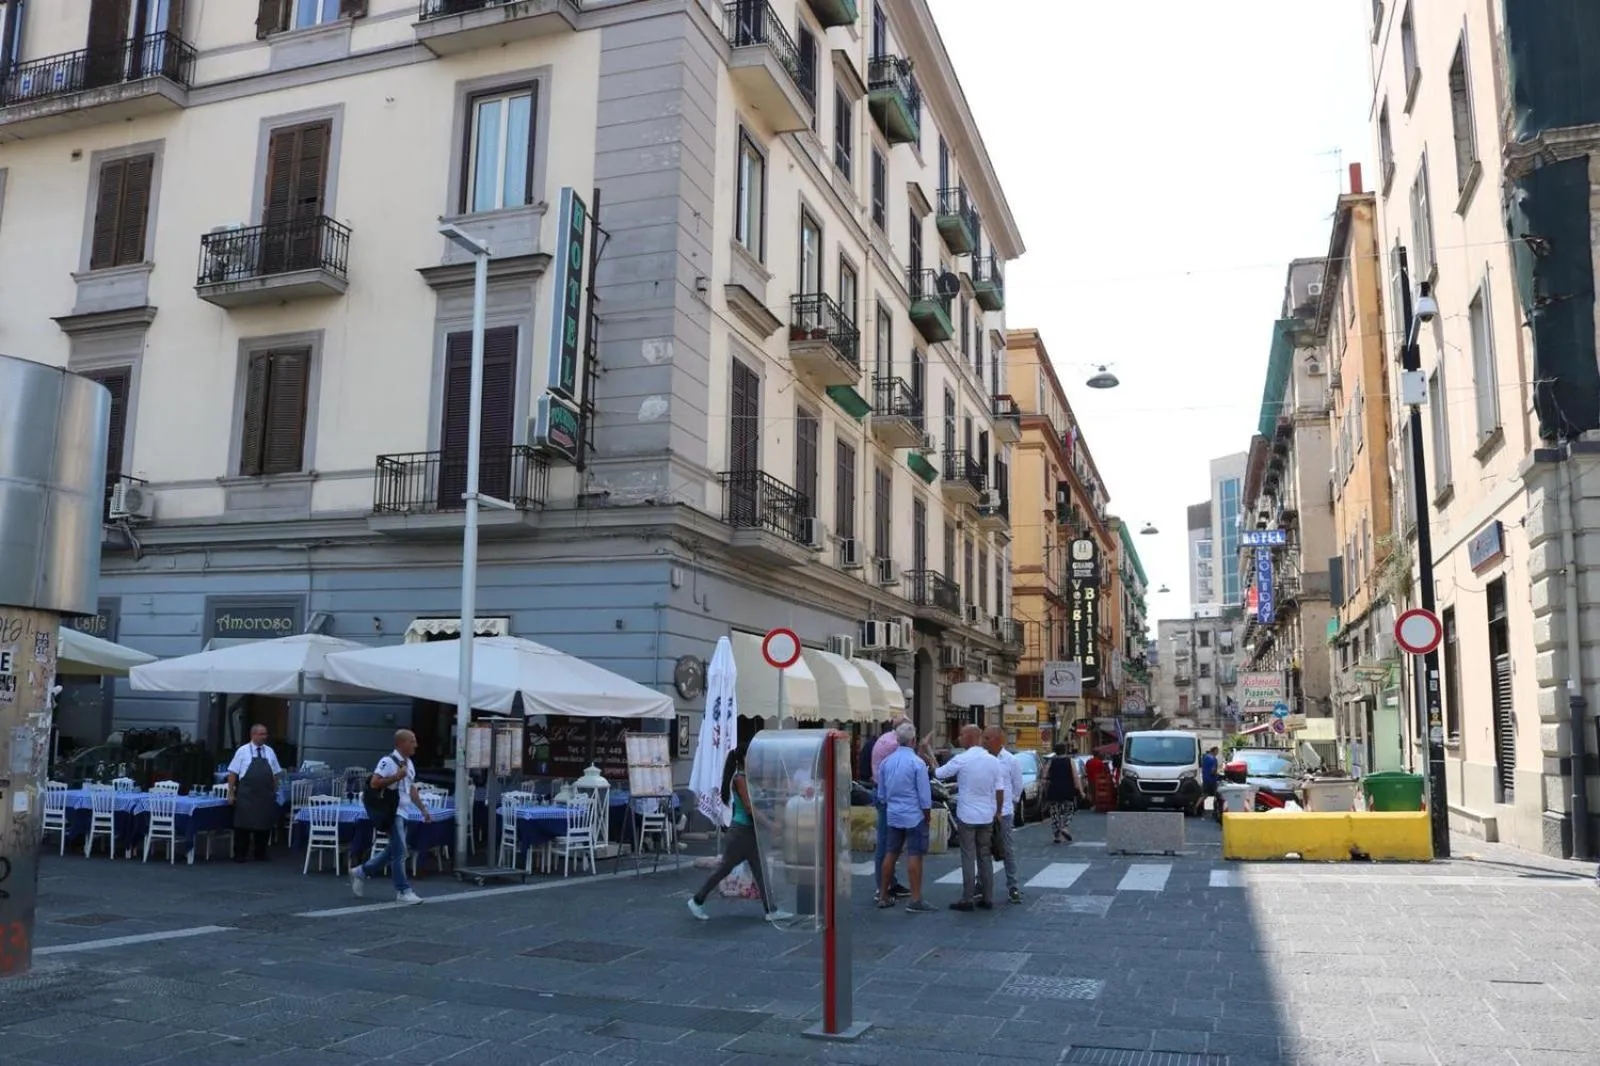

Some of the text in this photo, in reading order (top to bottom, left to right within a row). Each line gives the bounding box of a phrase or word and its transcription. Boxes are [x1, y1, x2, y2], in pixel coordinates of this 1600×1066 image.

[560, 199, 582, 386] HOTEL
[1242, 531, 1285, 544] HOTEL
[1258, 551, 1271, 622] HOLIDAY
[216, 613, 293, 632] Amoroso
[1084, 588, 1095, 665] Billia
[1244, 688, 1274, 697] Pizzeria
